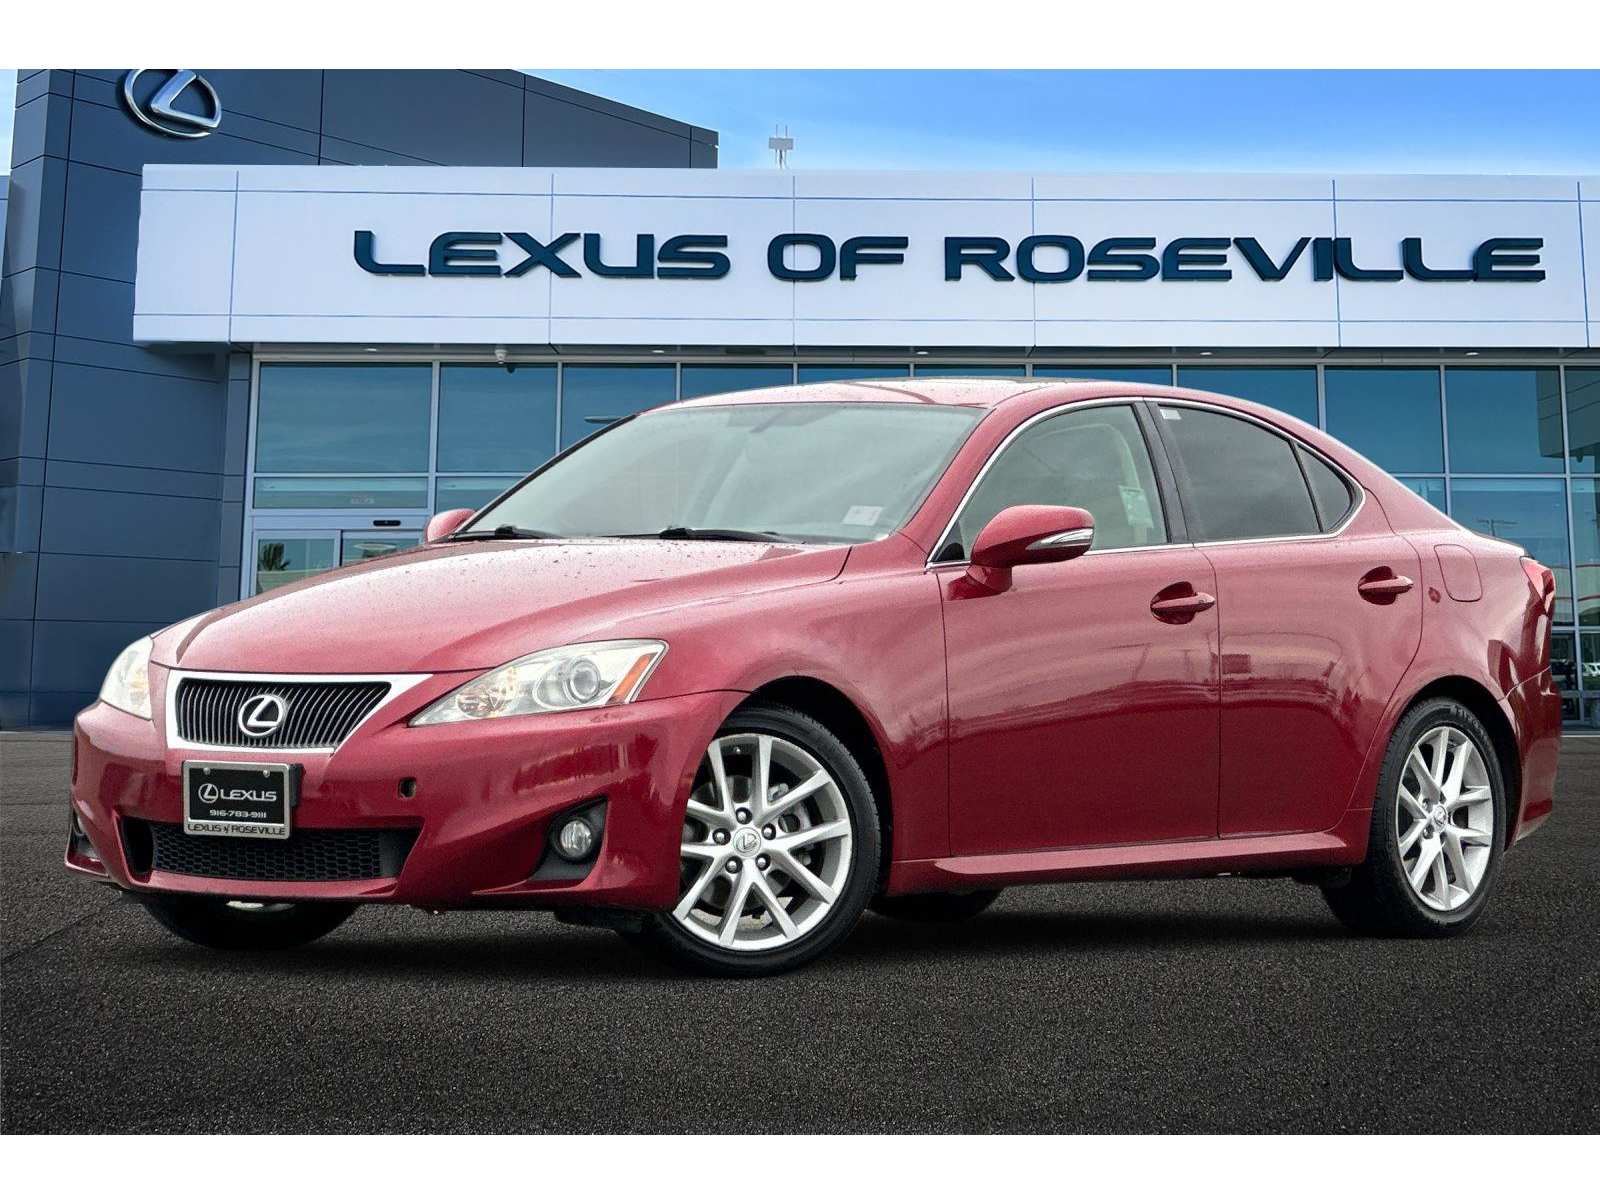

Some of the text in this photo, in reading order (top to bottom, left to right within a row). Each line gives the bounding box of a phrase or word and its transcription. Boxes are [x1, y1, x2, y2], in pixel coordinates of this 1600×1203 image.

[354, 230, 1547, 283] LEXUS OF ROSEVILLE
[220, 788, 277, 802] LEXUS
[209, 809, 267, 819] 916-783-9111
[187, 823, 221, 833] LEXUS
[231, 824, 286, 836] ROSEVILLE
